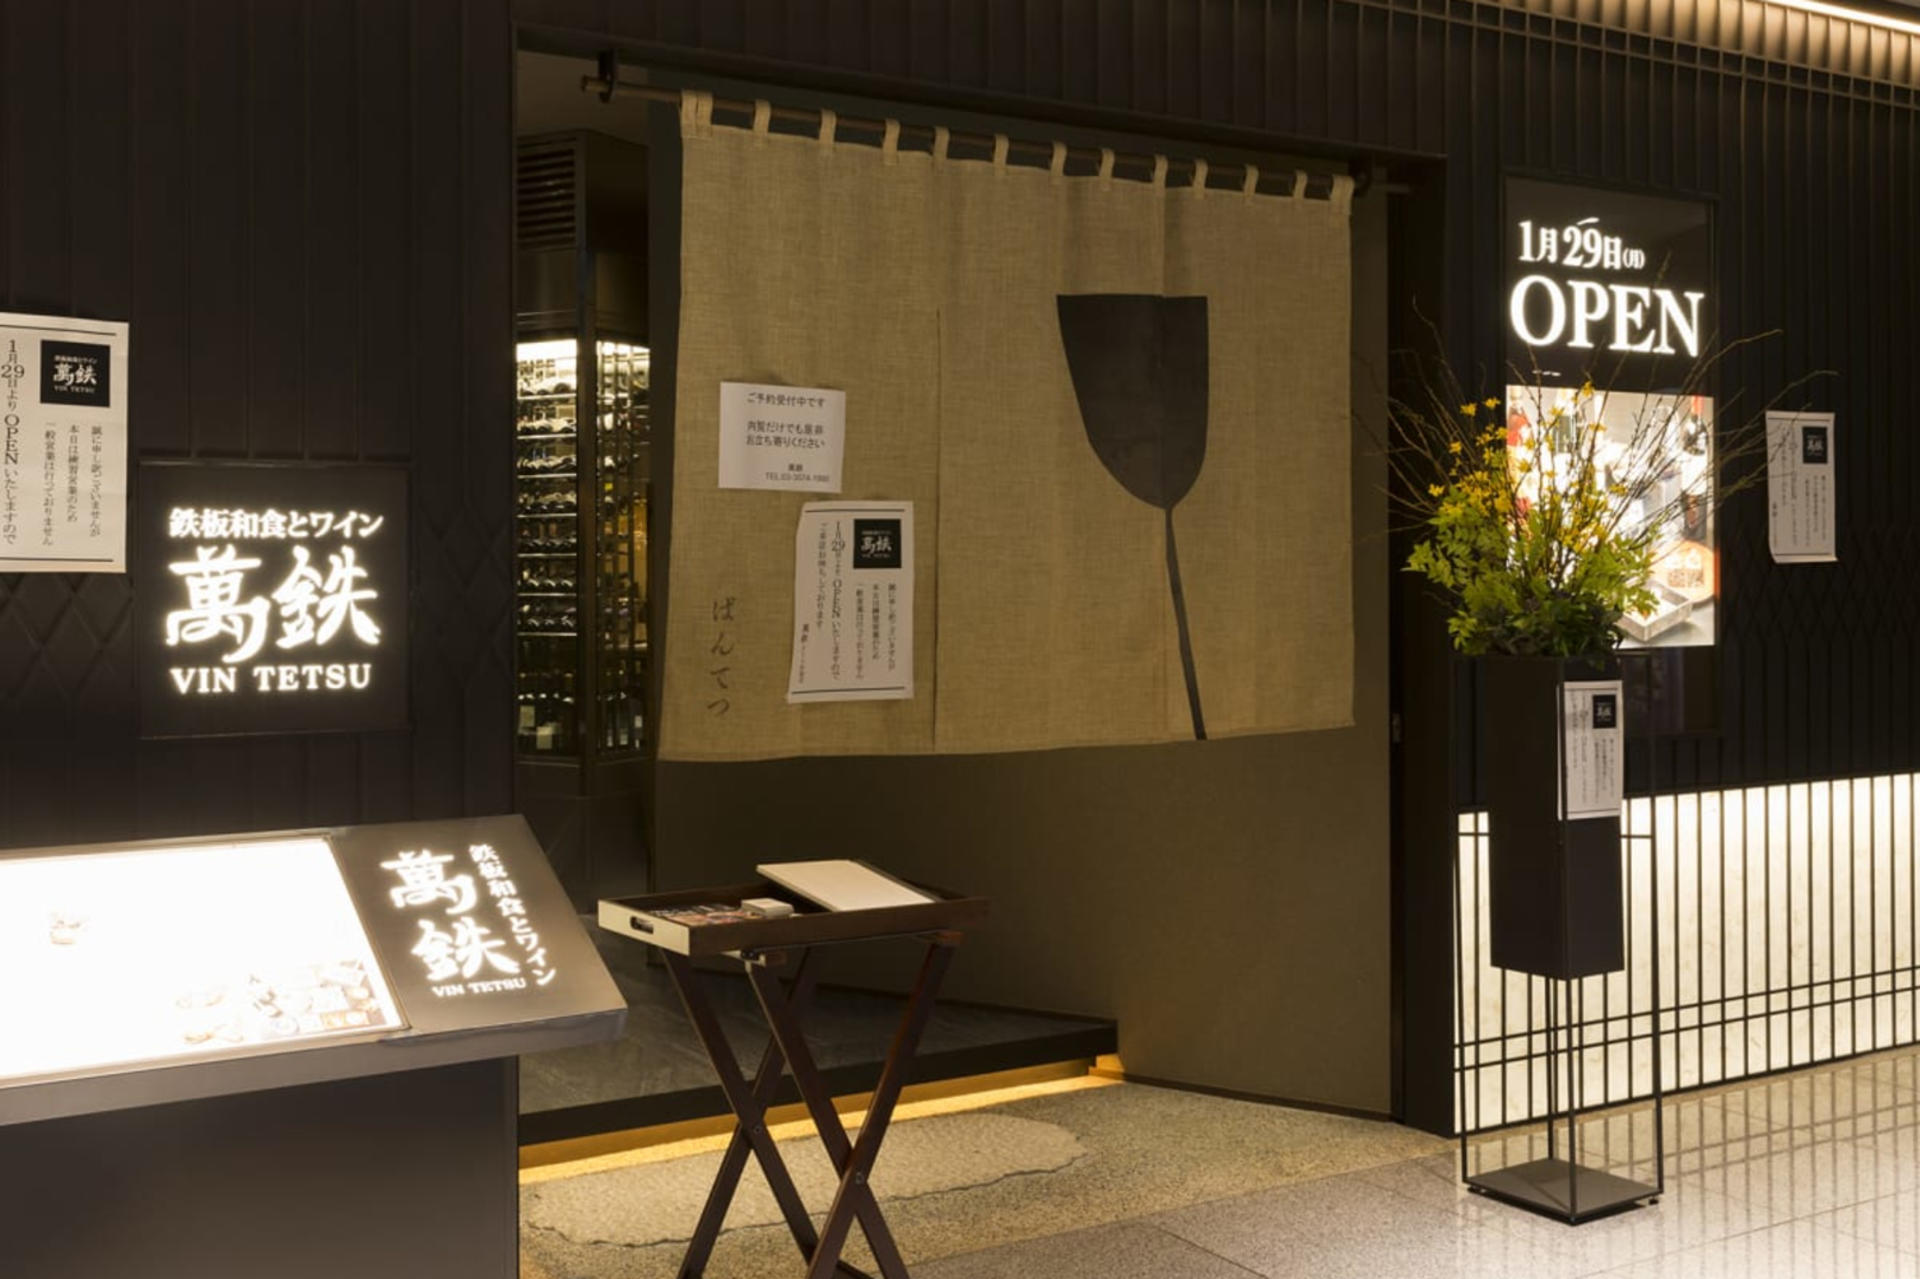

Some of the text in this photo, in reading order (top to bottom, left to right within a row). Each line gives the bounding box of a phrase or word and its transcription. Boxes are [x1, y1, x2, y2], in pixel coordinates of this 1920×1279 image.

[1510, 275, 1705, 357] OPEN
[169, 507, 384, 539] 鉄板和食とワイン
[165, 544, 382, 664] 萬鉄
[170, 663, 372, 694] VIN TETSU
[707, 597, 736, 717] ばんてつ
[380, 850, 521, 981] 萬鉄
[432, 978, 527, 997] VIN TETSU
